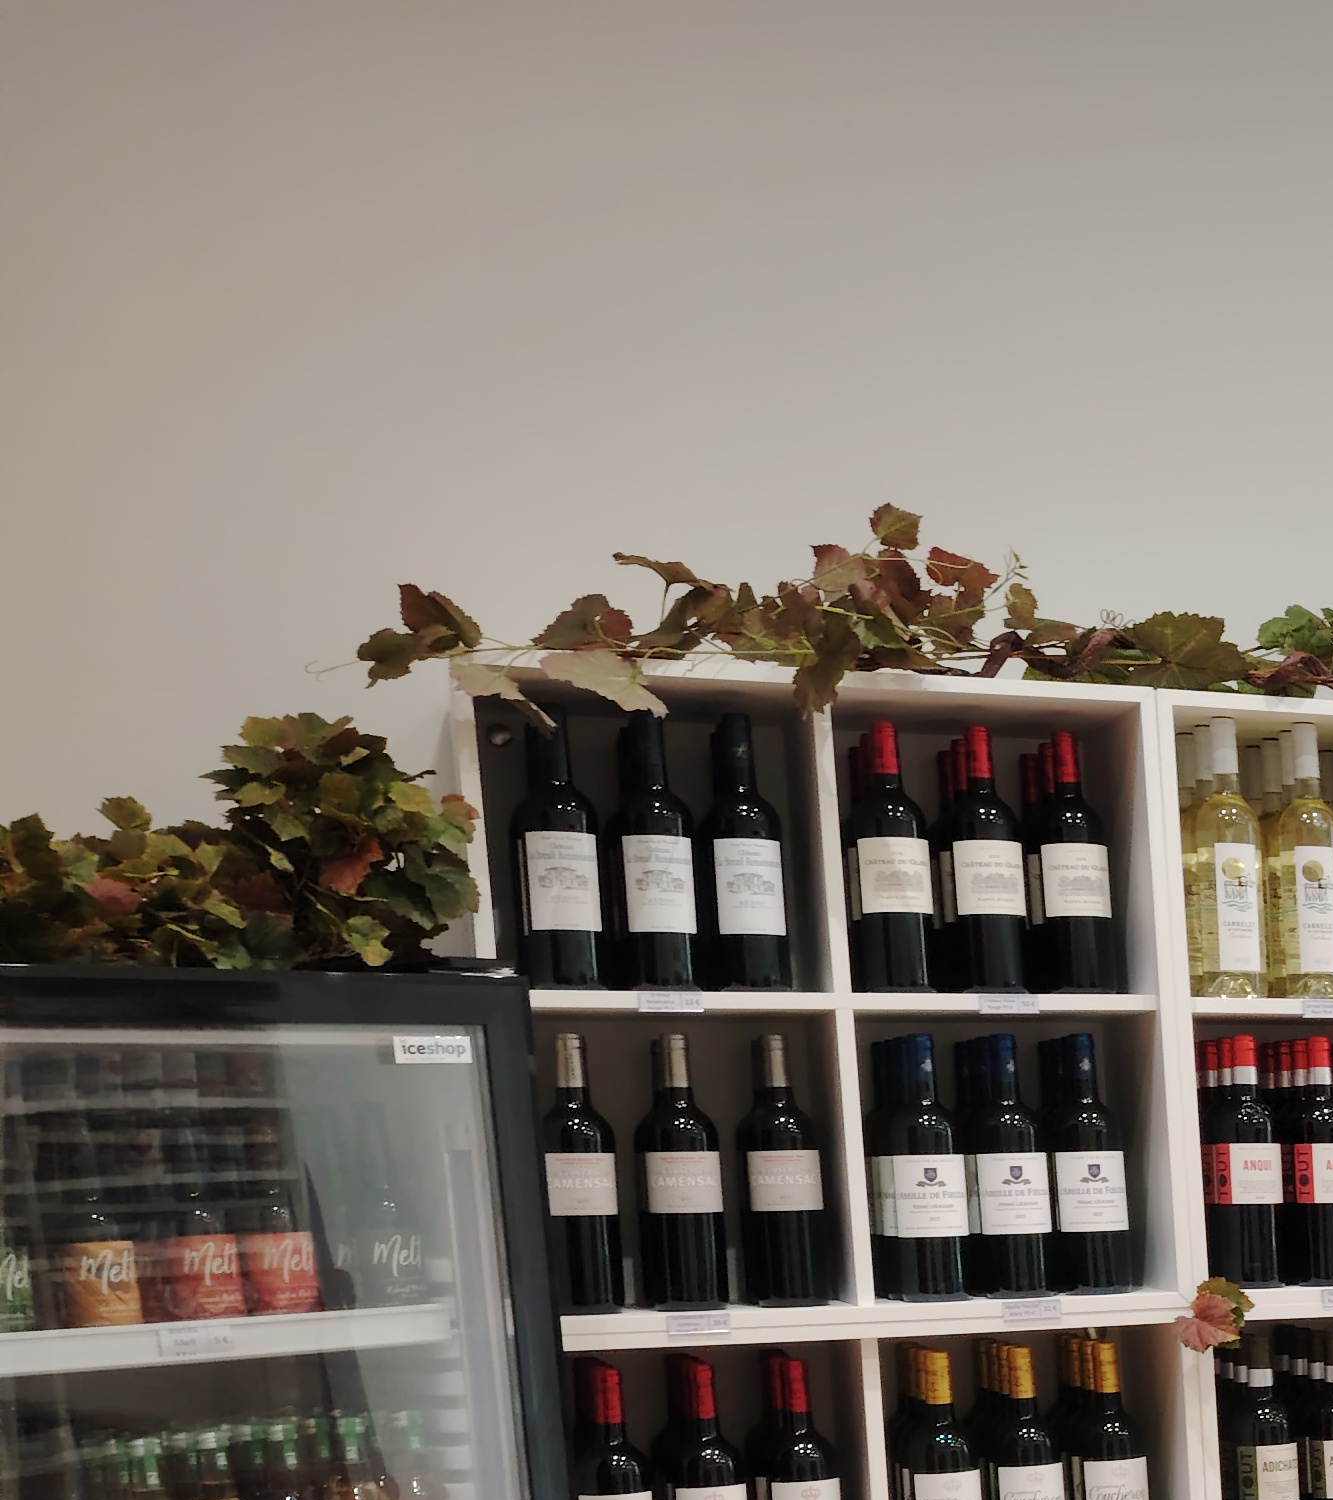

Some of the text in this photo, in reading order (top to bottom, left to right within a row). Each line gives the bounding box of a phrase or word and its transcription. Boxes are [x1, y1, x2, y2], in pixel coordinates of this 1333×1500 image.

[401, 1040, 467, 1058] iceshop
[1243, 1158, 1272, 1171] ANQUI
[1297, 1149, 1311, 1198] TOUT
[80, 1247, 137, 1295] Melt
[183, 1241, 239, 1286] Melt
[263, 1238, 315, 1284] Melt
[373, 1234, 423, 1277] Melt
[1240, 1451, 1255, 1500] TOUT
